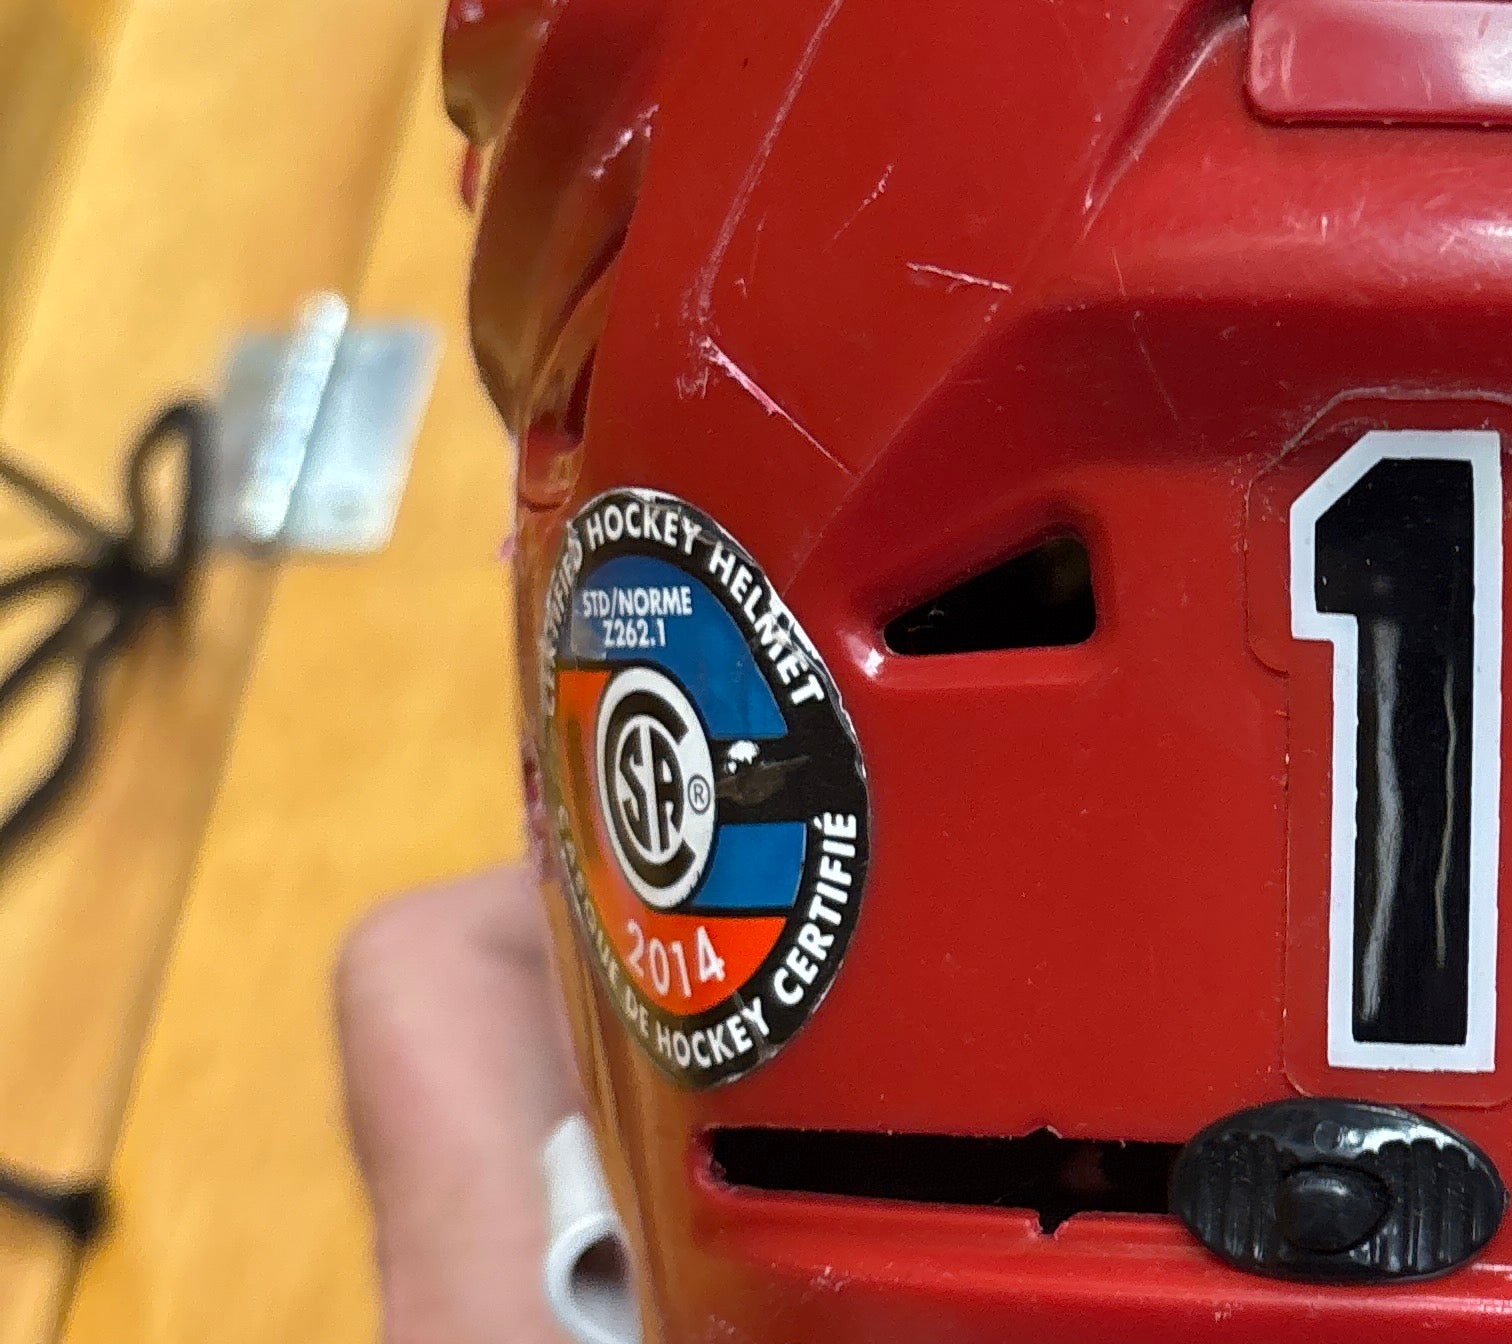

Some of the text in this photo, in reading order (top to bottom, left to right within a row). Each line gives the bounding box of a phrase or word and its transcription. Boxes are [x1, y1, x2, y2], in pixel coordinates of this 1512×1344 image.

[582, 586, 693, 619] STD/NORME
[586, 502, 702, 555] HOCKEY
[709, 542, 825, 706] HELMET
[603, 617, 666, 648] Z262.1
[623, 985, 650, 1039] DE
[655, 1004, 772, 1070] HOCKEY
[772, 809, 858, 1006] CERTIFIÉ
[626, 918, 726, 998] 2014
